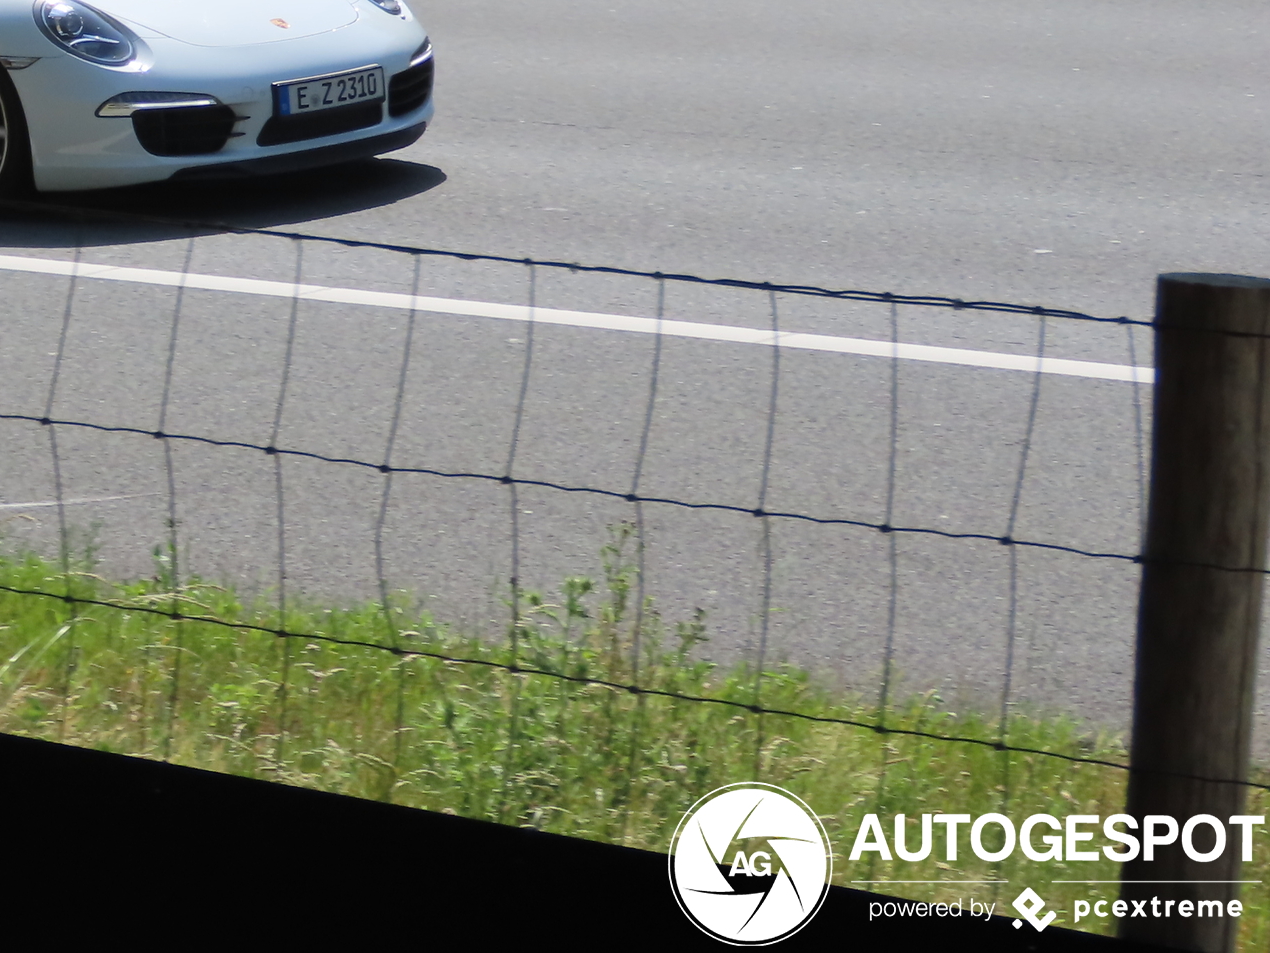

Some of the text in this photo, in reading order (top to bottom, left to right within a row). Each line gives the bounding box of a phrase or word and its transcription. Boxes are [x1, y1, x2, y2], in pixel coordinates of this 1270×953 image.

[297, 73, 378, 110] E Z 2310
